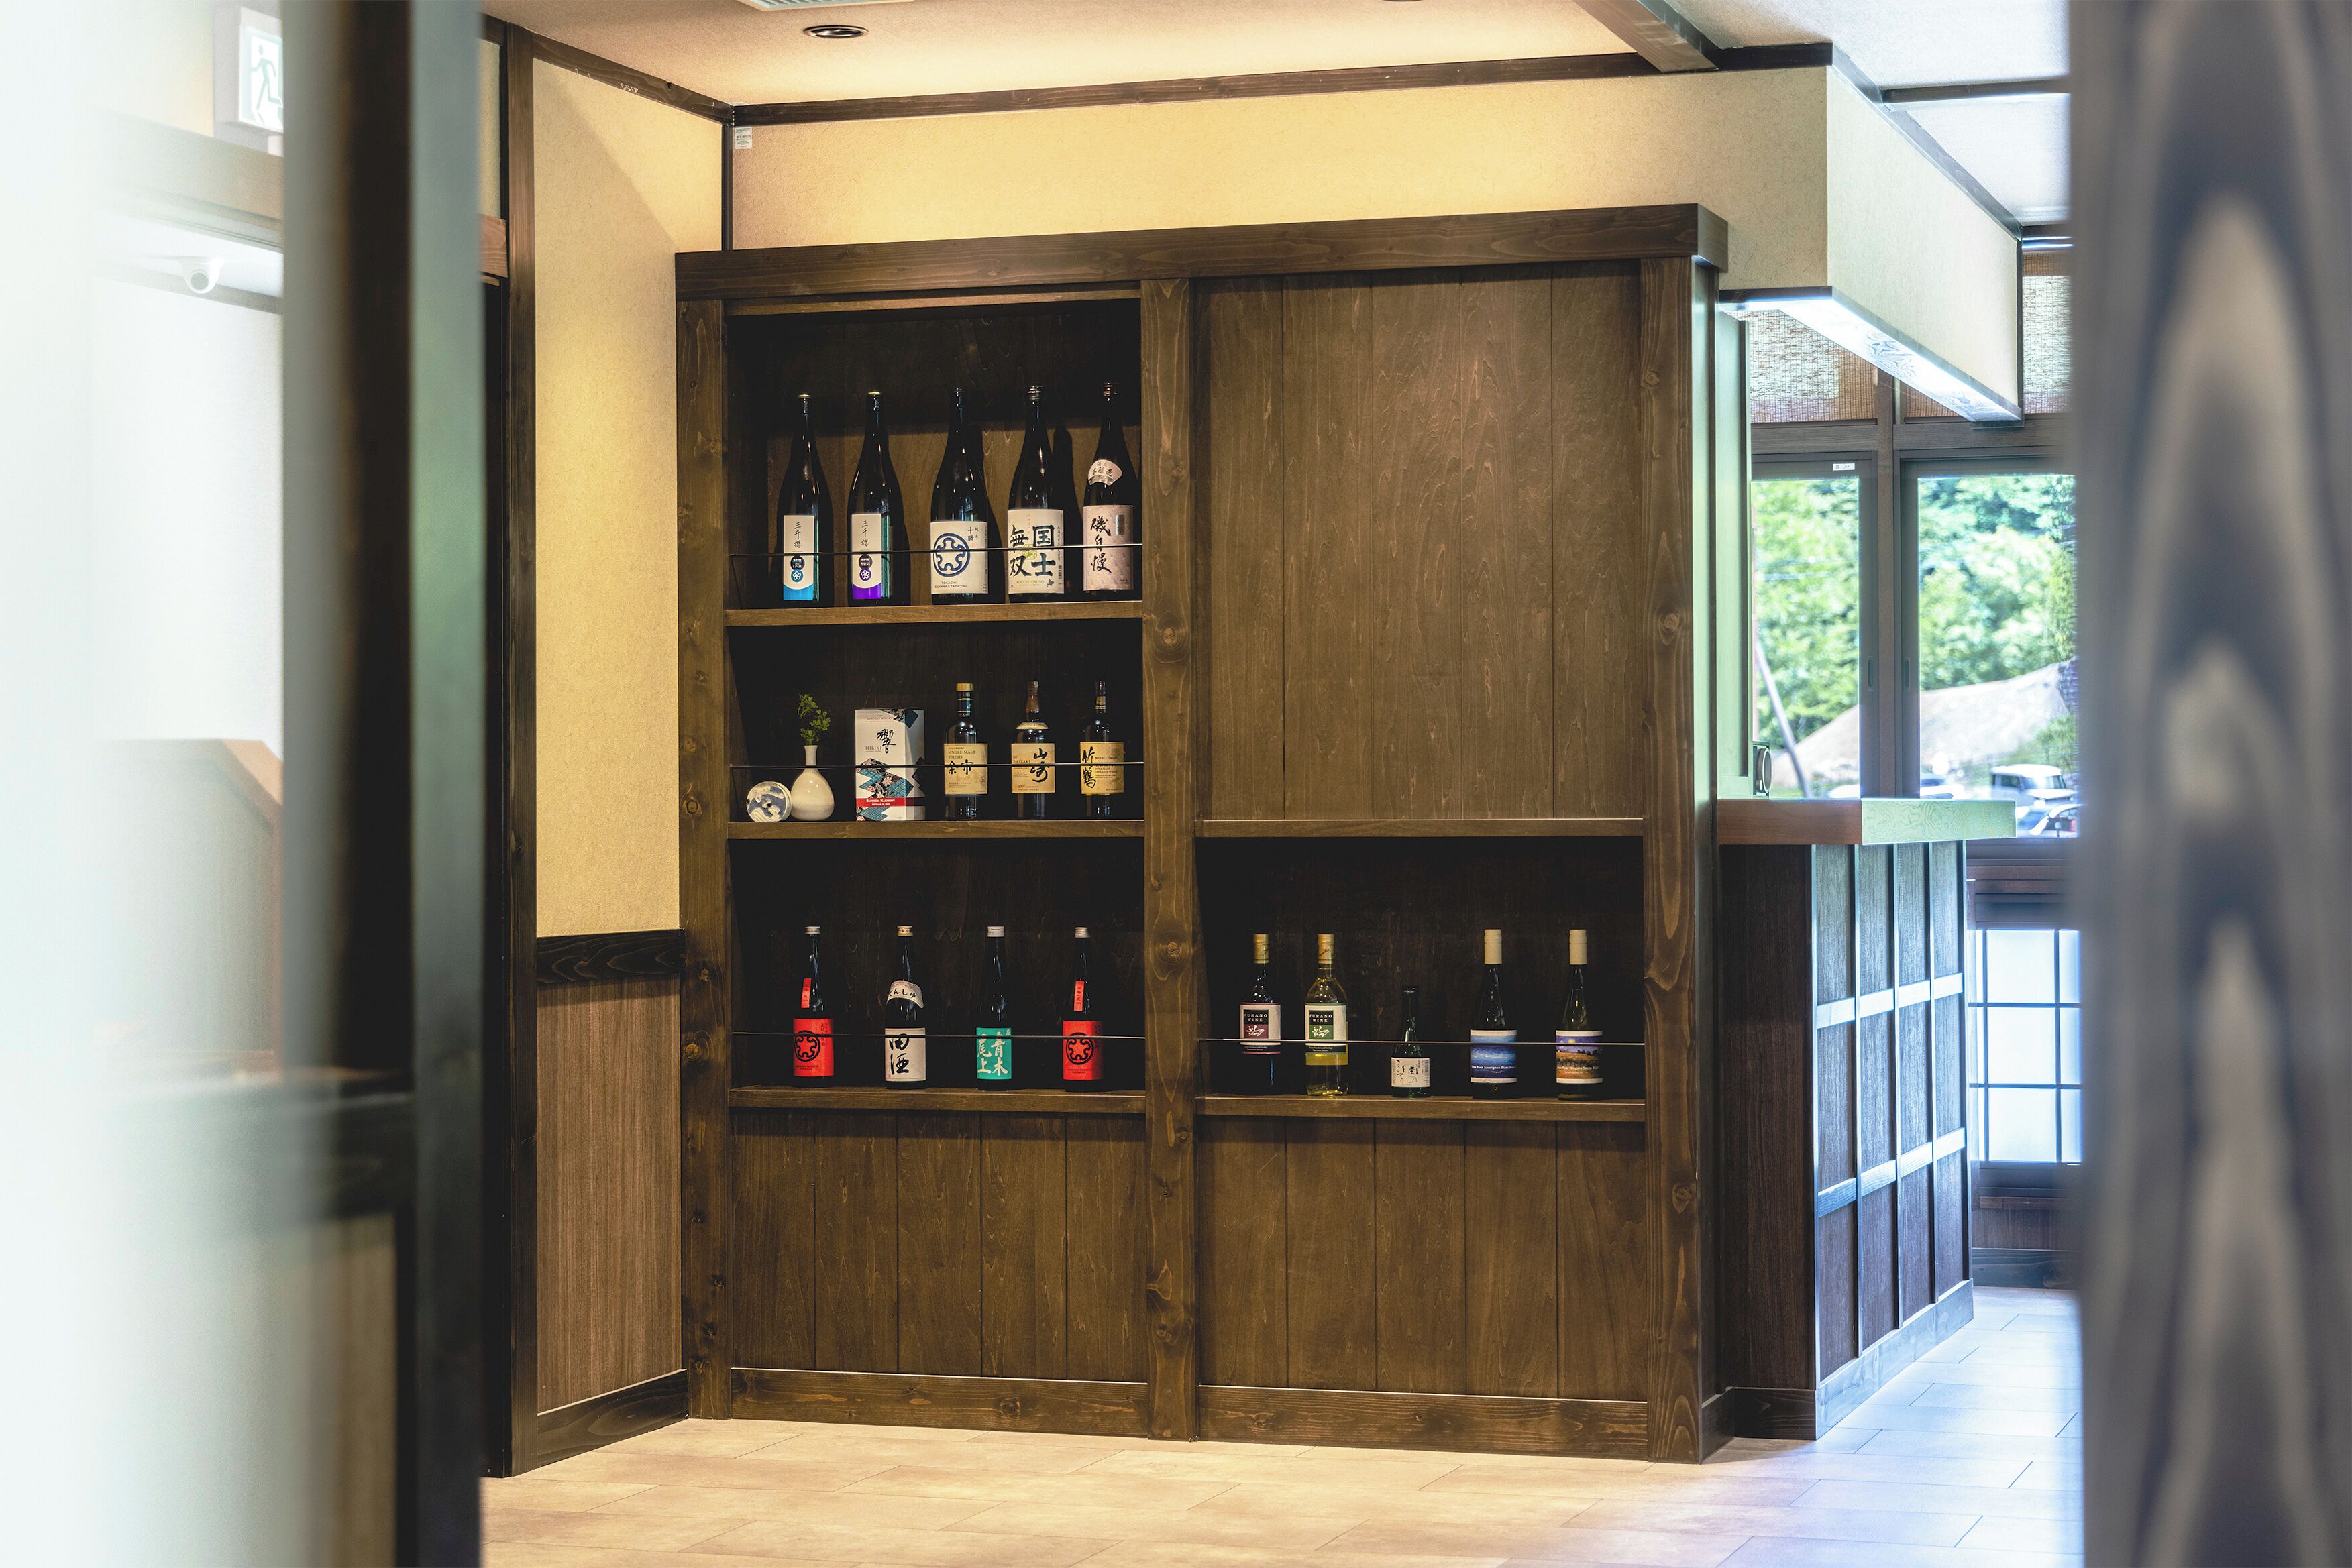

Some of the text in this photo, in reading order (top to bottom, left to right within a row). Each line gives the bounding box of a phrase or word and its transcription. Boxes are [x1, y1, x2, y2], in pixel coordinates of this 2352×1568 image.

[967, 526, 974, 541] 十勝
[1010, 524, 1032, 577] 無双
[1031, 524, 1056, 577] 国士
